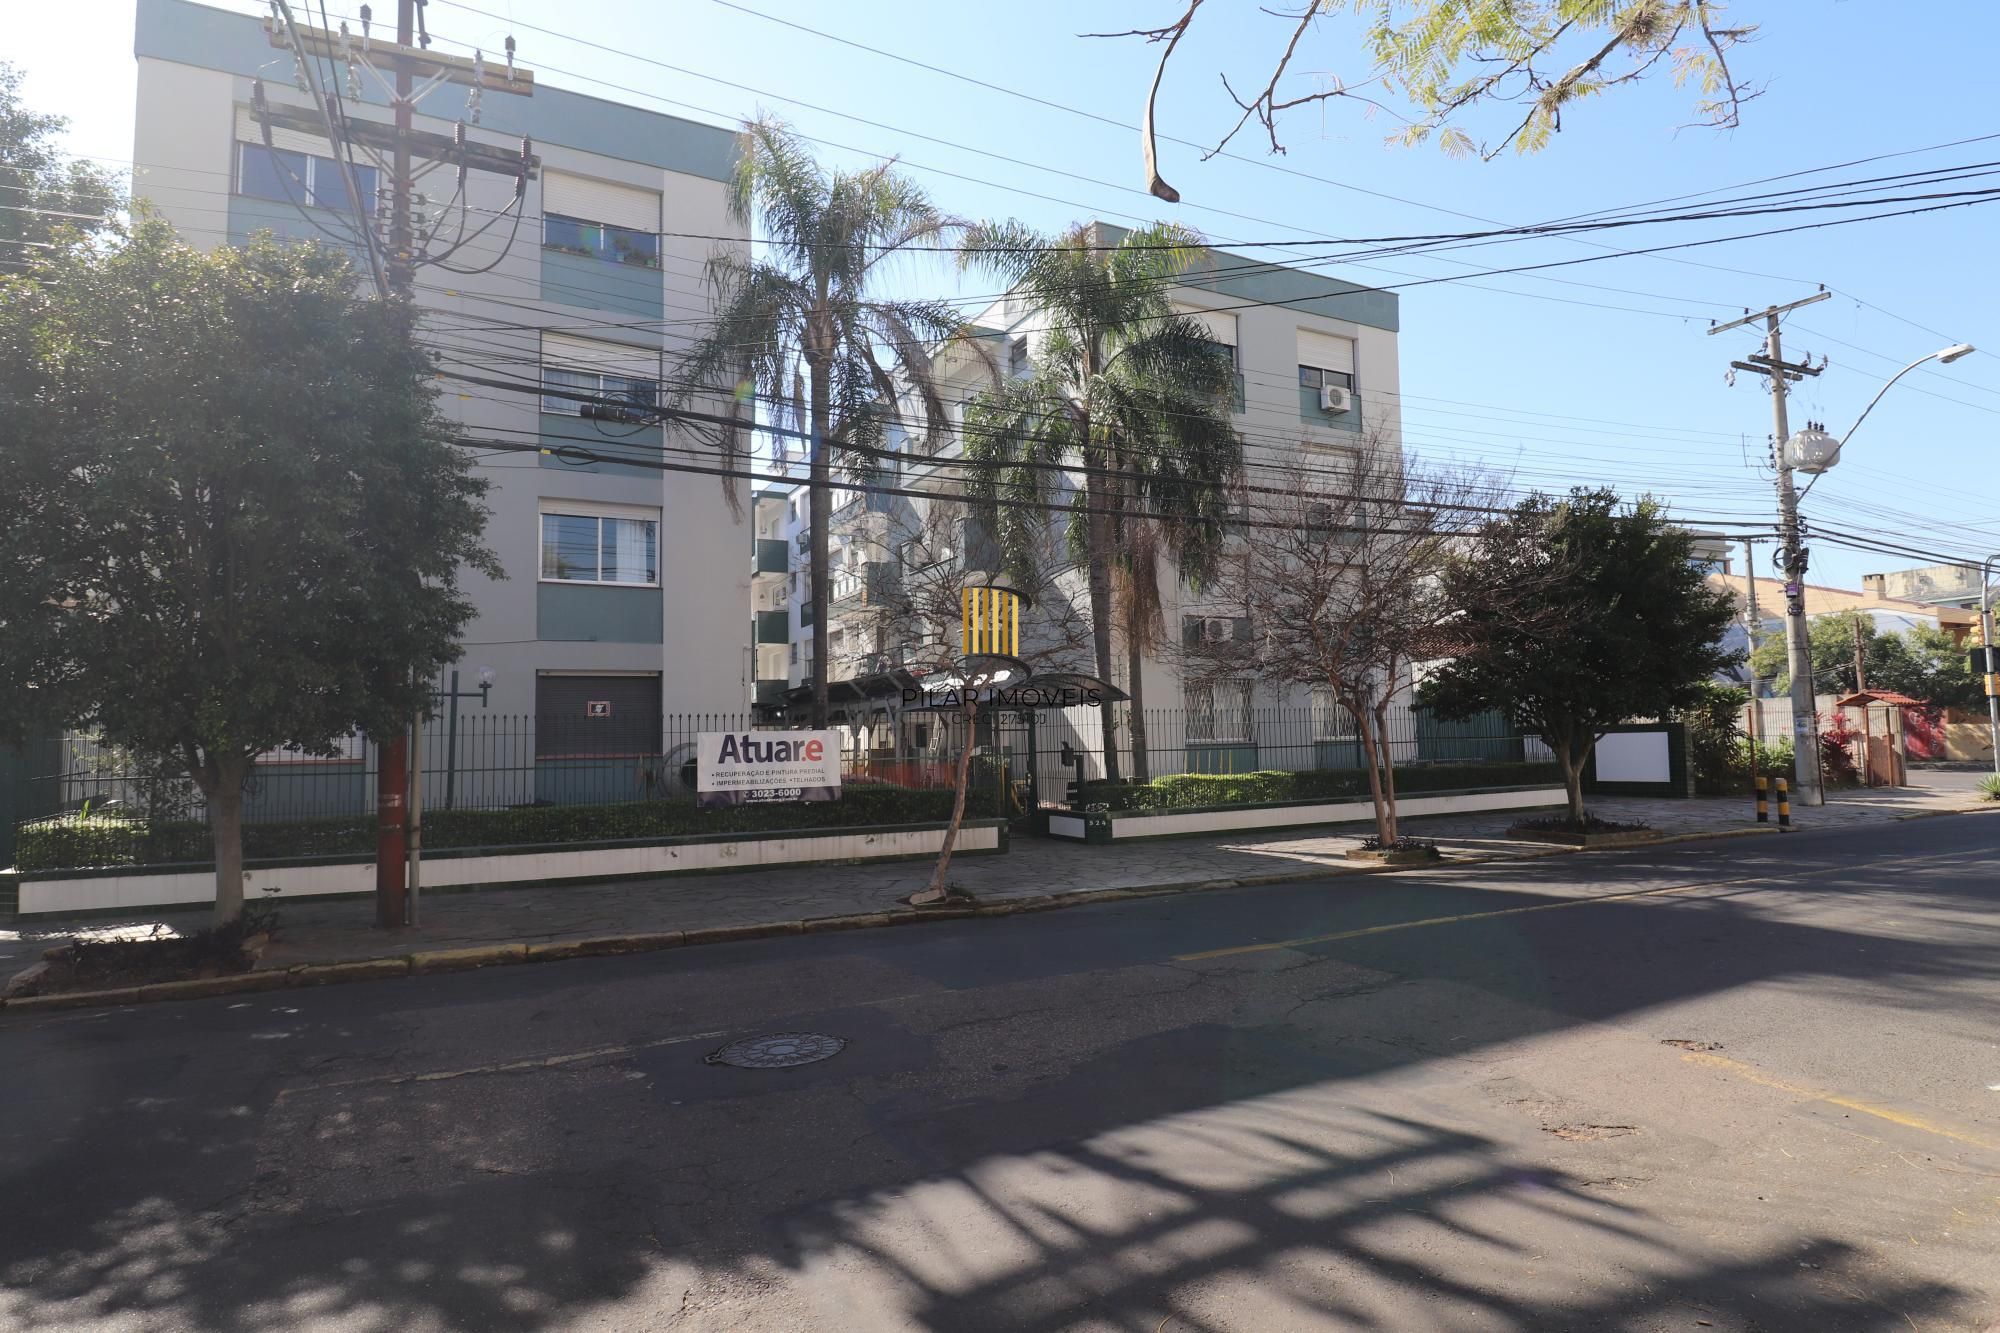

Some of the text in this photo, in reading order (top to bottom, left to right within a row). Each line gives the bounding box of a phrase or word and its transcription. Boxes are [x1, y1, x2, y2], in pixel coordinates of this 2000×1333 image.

[715, 769, 764, 778] RECUPERAÇÃO
[716, 776, 826, 786] IMPERMEABILIZAÇÕES TELHADOS
[751, 789, 801, 798] 3023-6000
